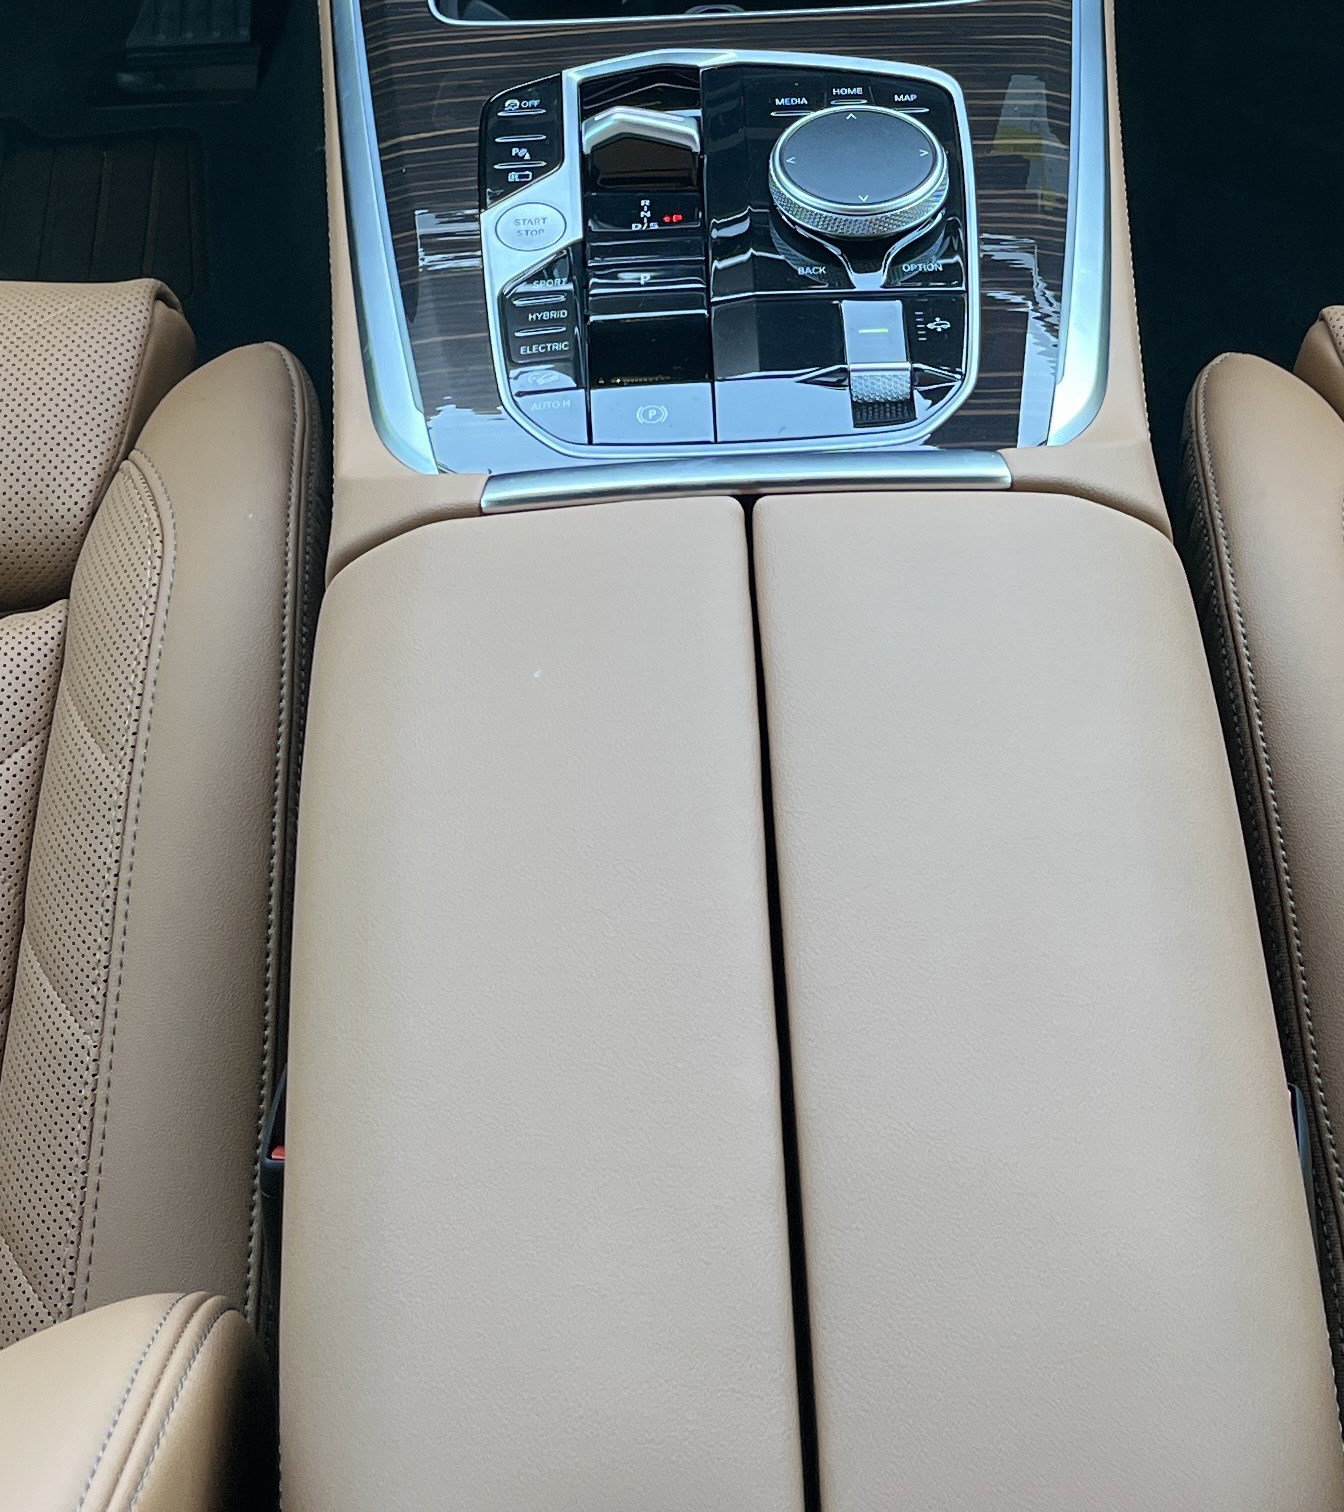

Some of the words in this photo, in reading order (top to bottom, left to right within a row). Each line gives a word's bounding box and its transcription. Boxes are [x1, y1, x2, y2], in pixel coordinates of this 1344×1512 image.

[832, 87, 864, 95] HOME
[774, 97, 808, 106] MEDIA
[894, 94, 918, 102] MAP
[520, 99, 541, 108] OFF
[513, 216, 549, 227] START
[516, 228, 545, 237] STOP
[797, 266, 827, 276] BACK
[901, 262, 944, 273] OPTION
[532, 277, 568, 288] SPORT
[528, 309, 568, 322] HYBRID
[519, 341, 570, 355] ELECTRIC
[530, 401, 559, 412] AUTO
